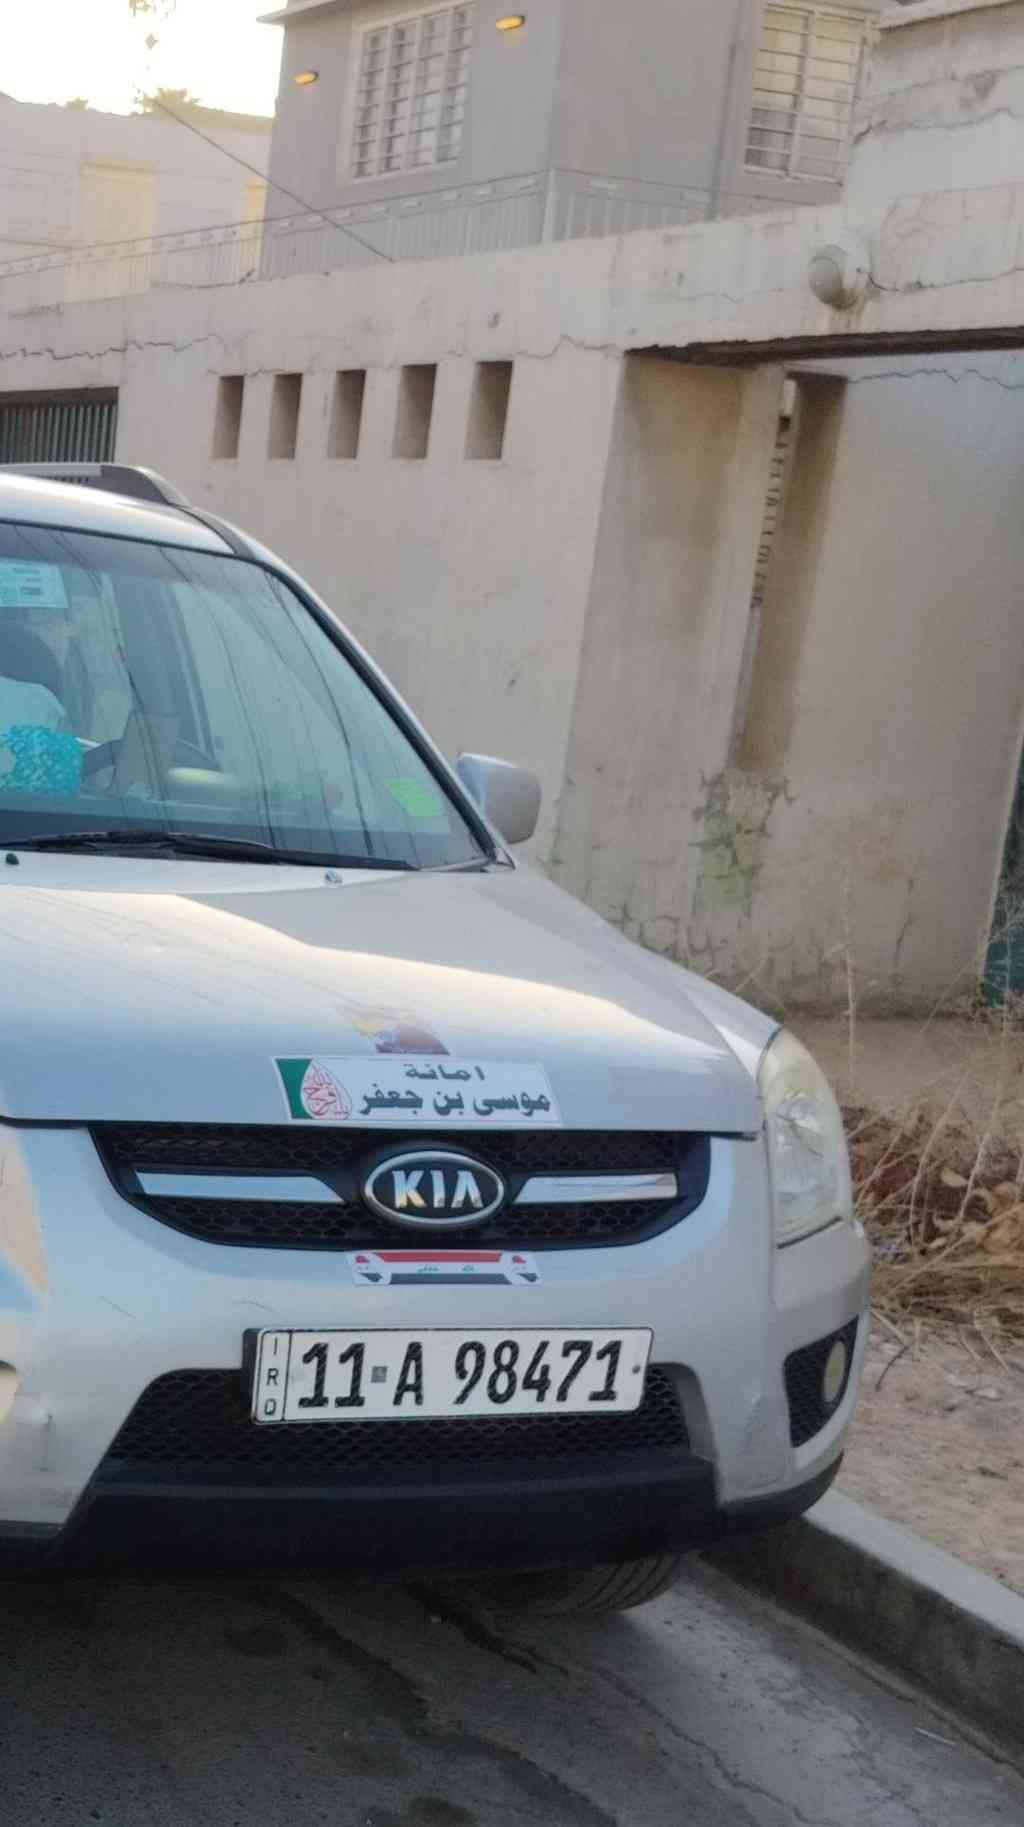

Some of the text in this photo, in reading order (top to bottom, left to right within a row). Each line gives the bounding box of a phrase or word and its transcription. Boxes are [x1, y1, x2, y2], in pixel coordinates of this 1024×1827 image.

[404, 1063, 486, 1081] امانة
[360, 1083, 424, 1116] جعفر
[433, 1090, 465, 1116] بن
[472, 1091, 551, 1117] موسى
[392, 1169, 484, 1209] KIA
[298, 1339, 622, 1408] 11 A 98471
